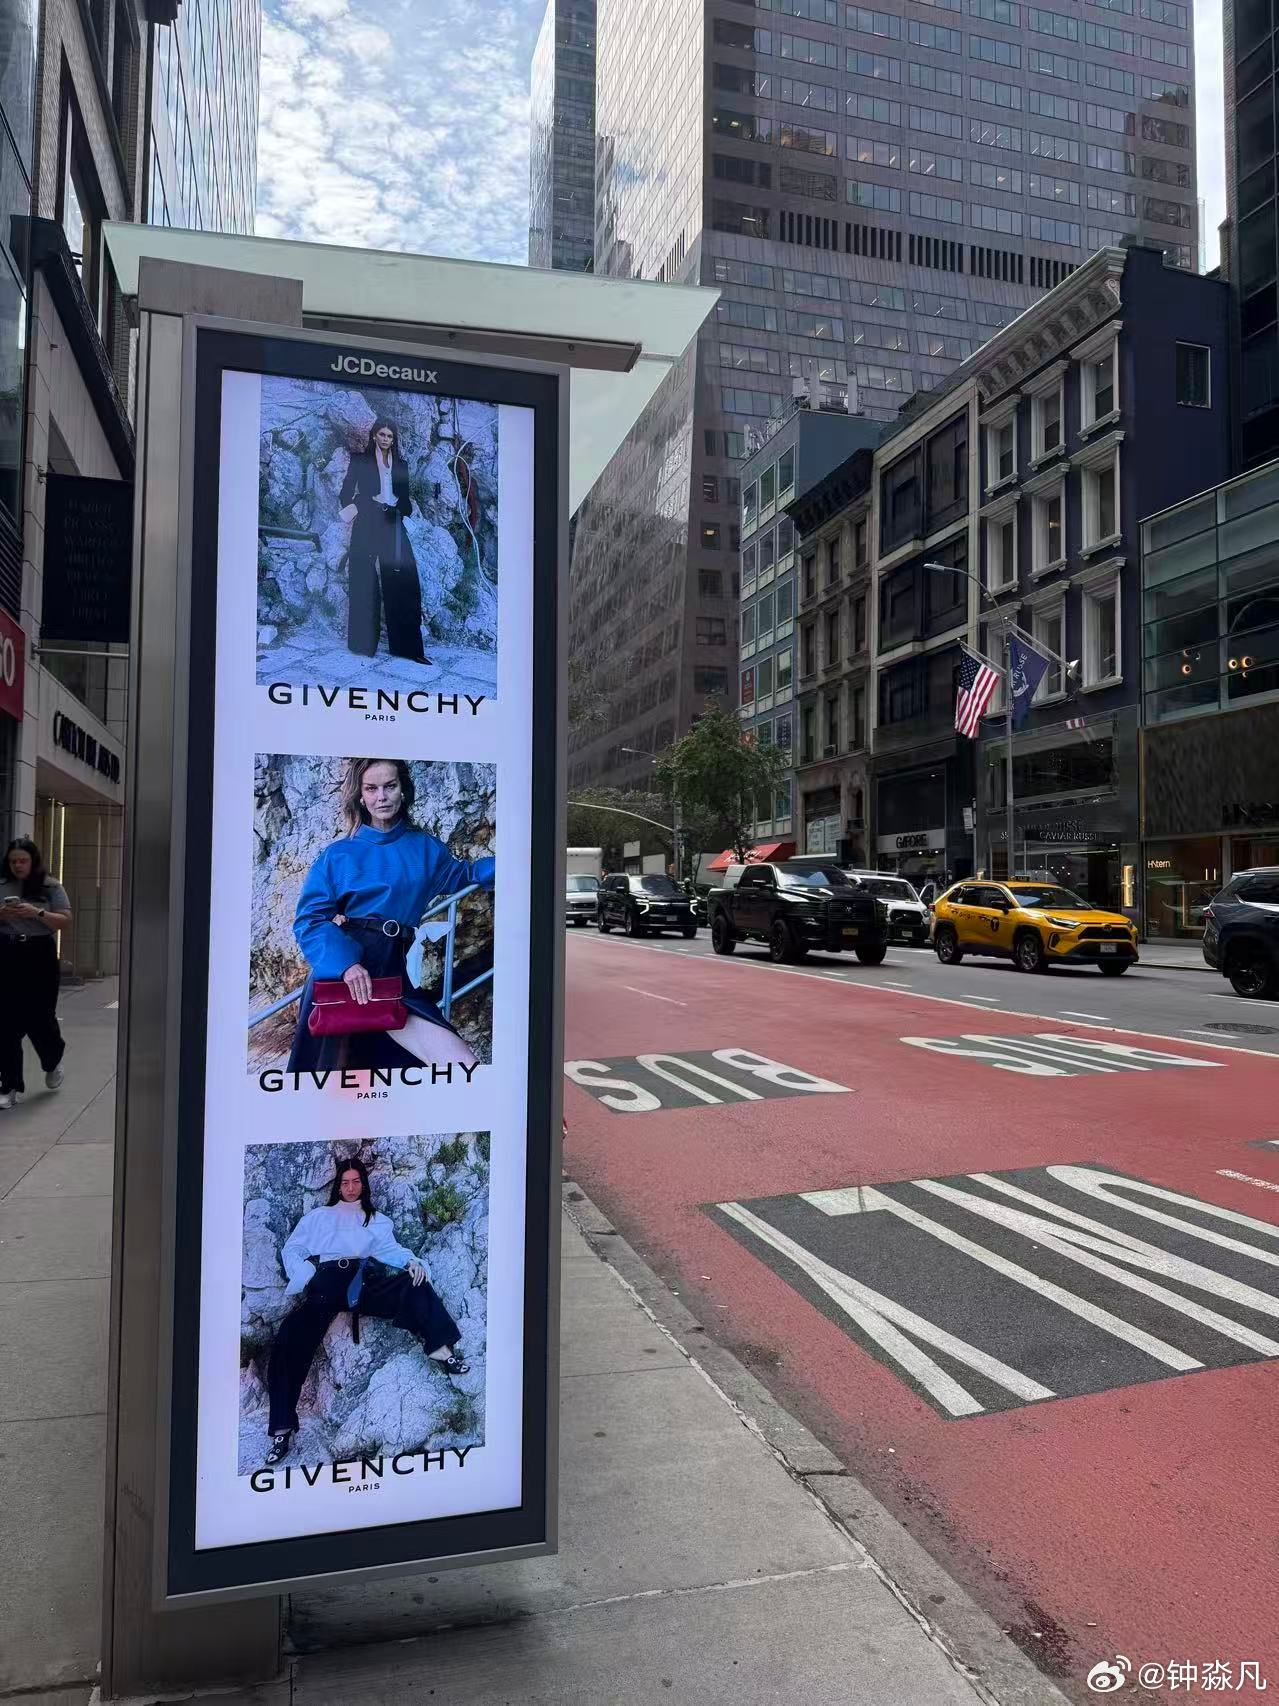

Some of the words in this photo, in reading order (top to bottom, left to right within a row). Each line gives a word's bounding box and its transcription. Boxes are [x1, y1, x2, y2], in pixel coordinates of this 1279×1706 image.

[330, 355, 438, 384] JCDecaux
[268, 682, 486, 716] GIVENCHY
[365, 713, 396, 722] PARIS
[1040, 831, 1072, 841] CAVIAR
[899, 1033, 1229, 1077] BUS
[259, 1061, 480, 1093] GIVENCHY
[563, 1048, 856, 1112] BUS
[357, 1091, 389, 1099] PARIS
[250, 1444, 473, 1493] GIVENCHY
[348, 1482, 380, 1493] PARIS
